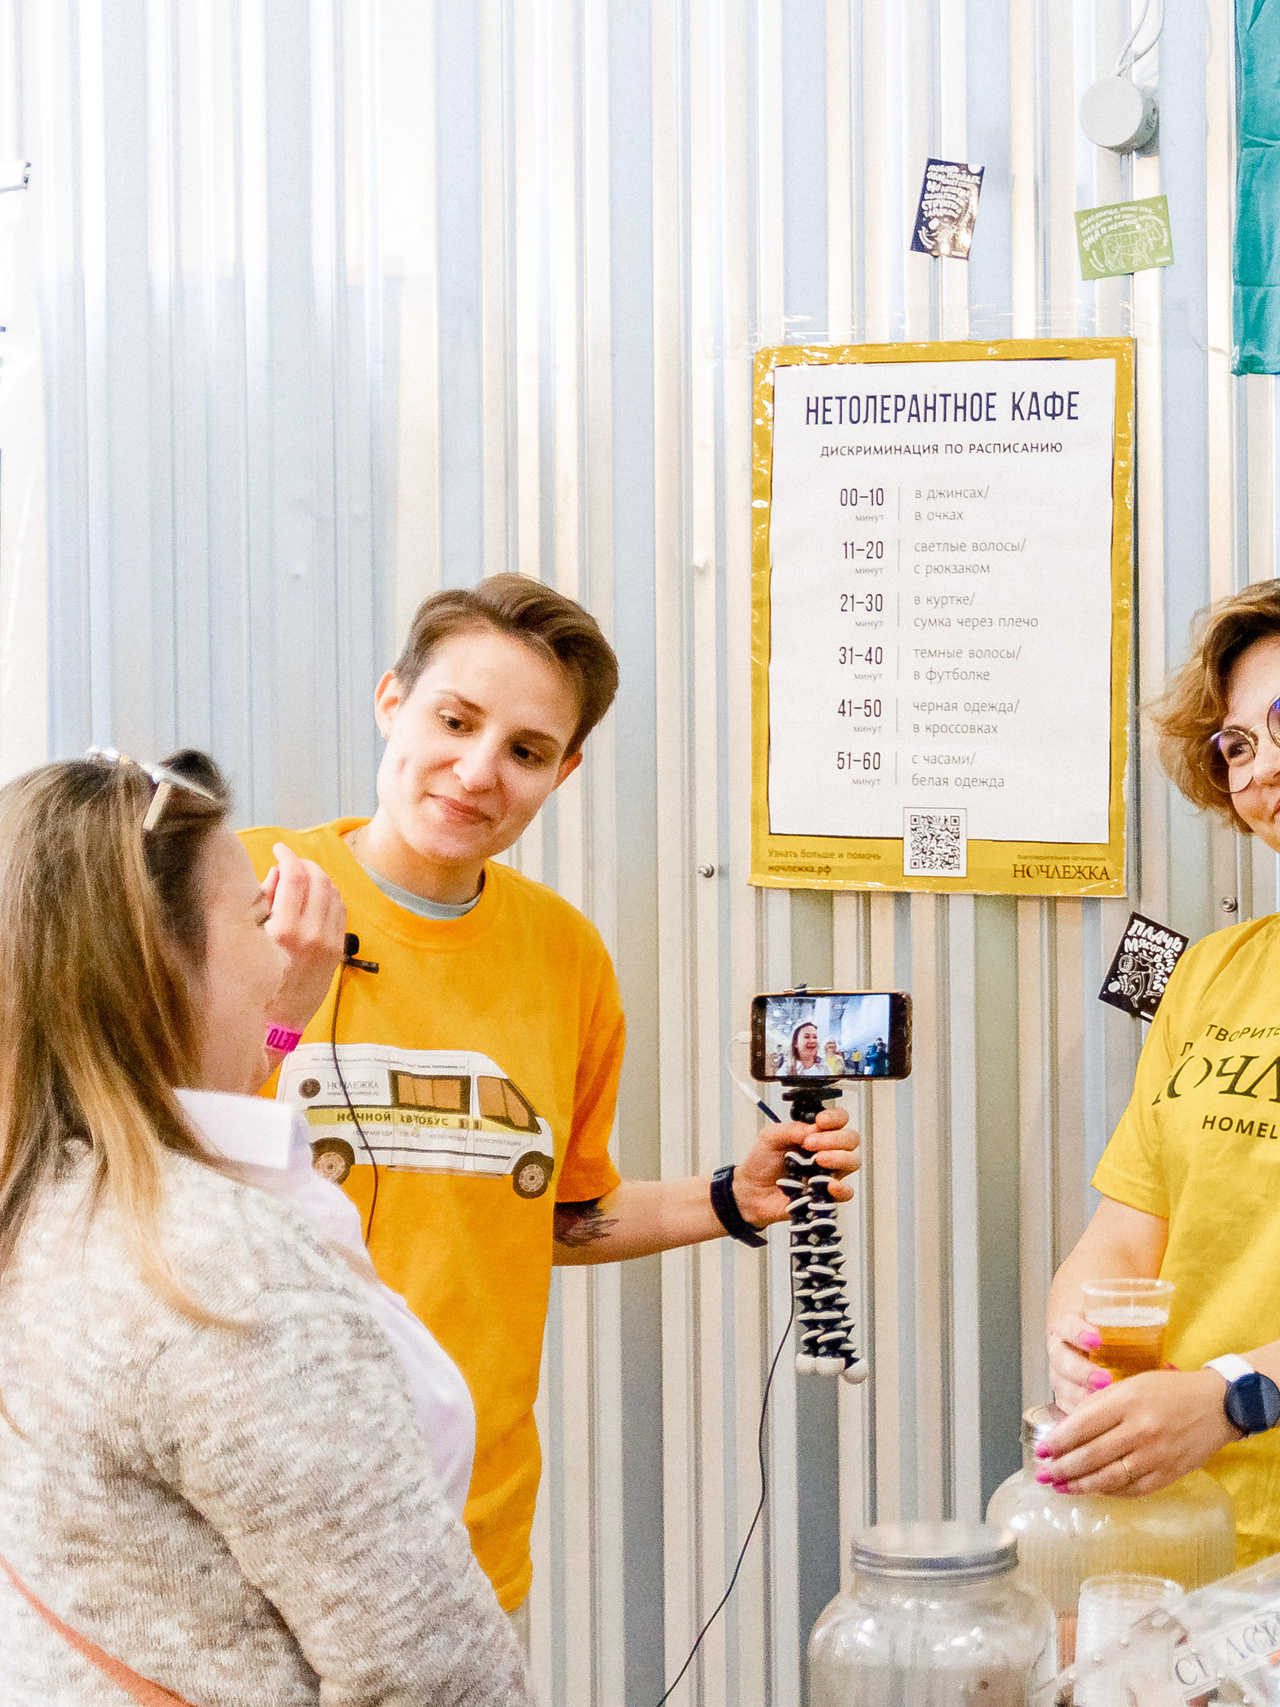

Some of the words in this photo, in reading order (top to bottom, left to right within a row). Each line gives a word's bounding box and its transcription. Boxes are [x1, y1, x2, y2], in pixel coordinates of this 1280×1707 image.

[805, 392, 998, 425] НЕТОЛЕРАНТНОЕ
[1011, 390, 1080, 421] КАФЕ
[820, 443, 939, 458] ДИСКРИМИНАЦИЯ
[945, 443, 964, 455] ПО
[968, 442, 1063, 455] РАСПИСАНИЮ
[927, 485, 989, 501] джинсах/
[927, 510, 964, 521] очках
[914, 541, 966, 552] светлые
[972, 539, 1026, 553] волосы/
[925, 563, 990, 578] рюкзаком
[926, 592, 976, 607] куртке/
[914, 616, 952, 630] сумка
[957, 617, 993, 629] через
[998, 616, 1039, 628] плечо
[913, 648, 963, 659] темные
[968, 646, 1022, 660] волосы/
[926, 668, 990, 684] футболке
[913, 701, 958, 713] черная
[963, 699, 1020, 713] одежда/
[925, 722, 998, 737] кроссовках
[923, 752, 976, 766] часами/
[912, 774, 949, 787] белая
[954, 775, 1005, 789] одежда
[768, 849, 798, 858] Узнать
[800, 849, 835, 859] больше
[847, 852, 881, 860] помочь
[768, 865, 832, 875] ночлежка.рф
[1012, 863, 1111, 881] НОЧЛЕЖКА
